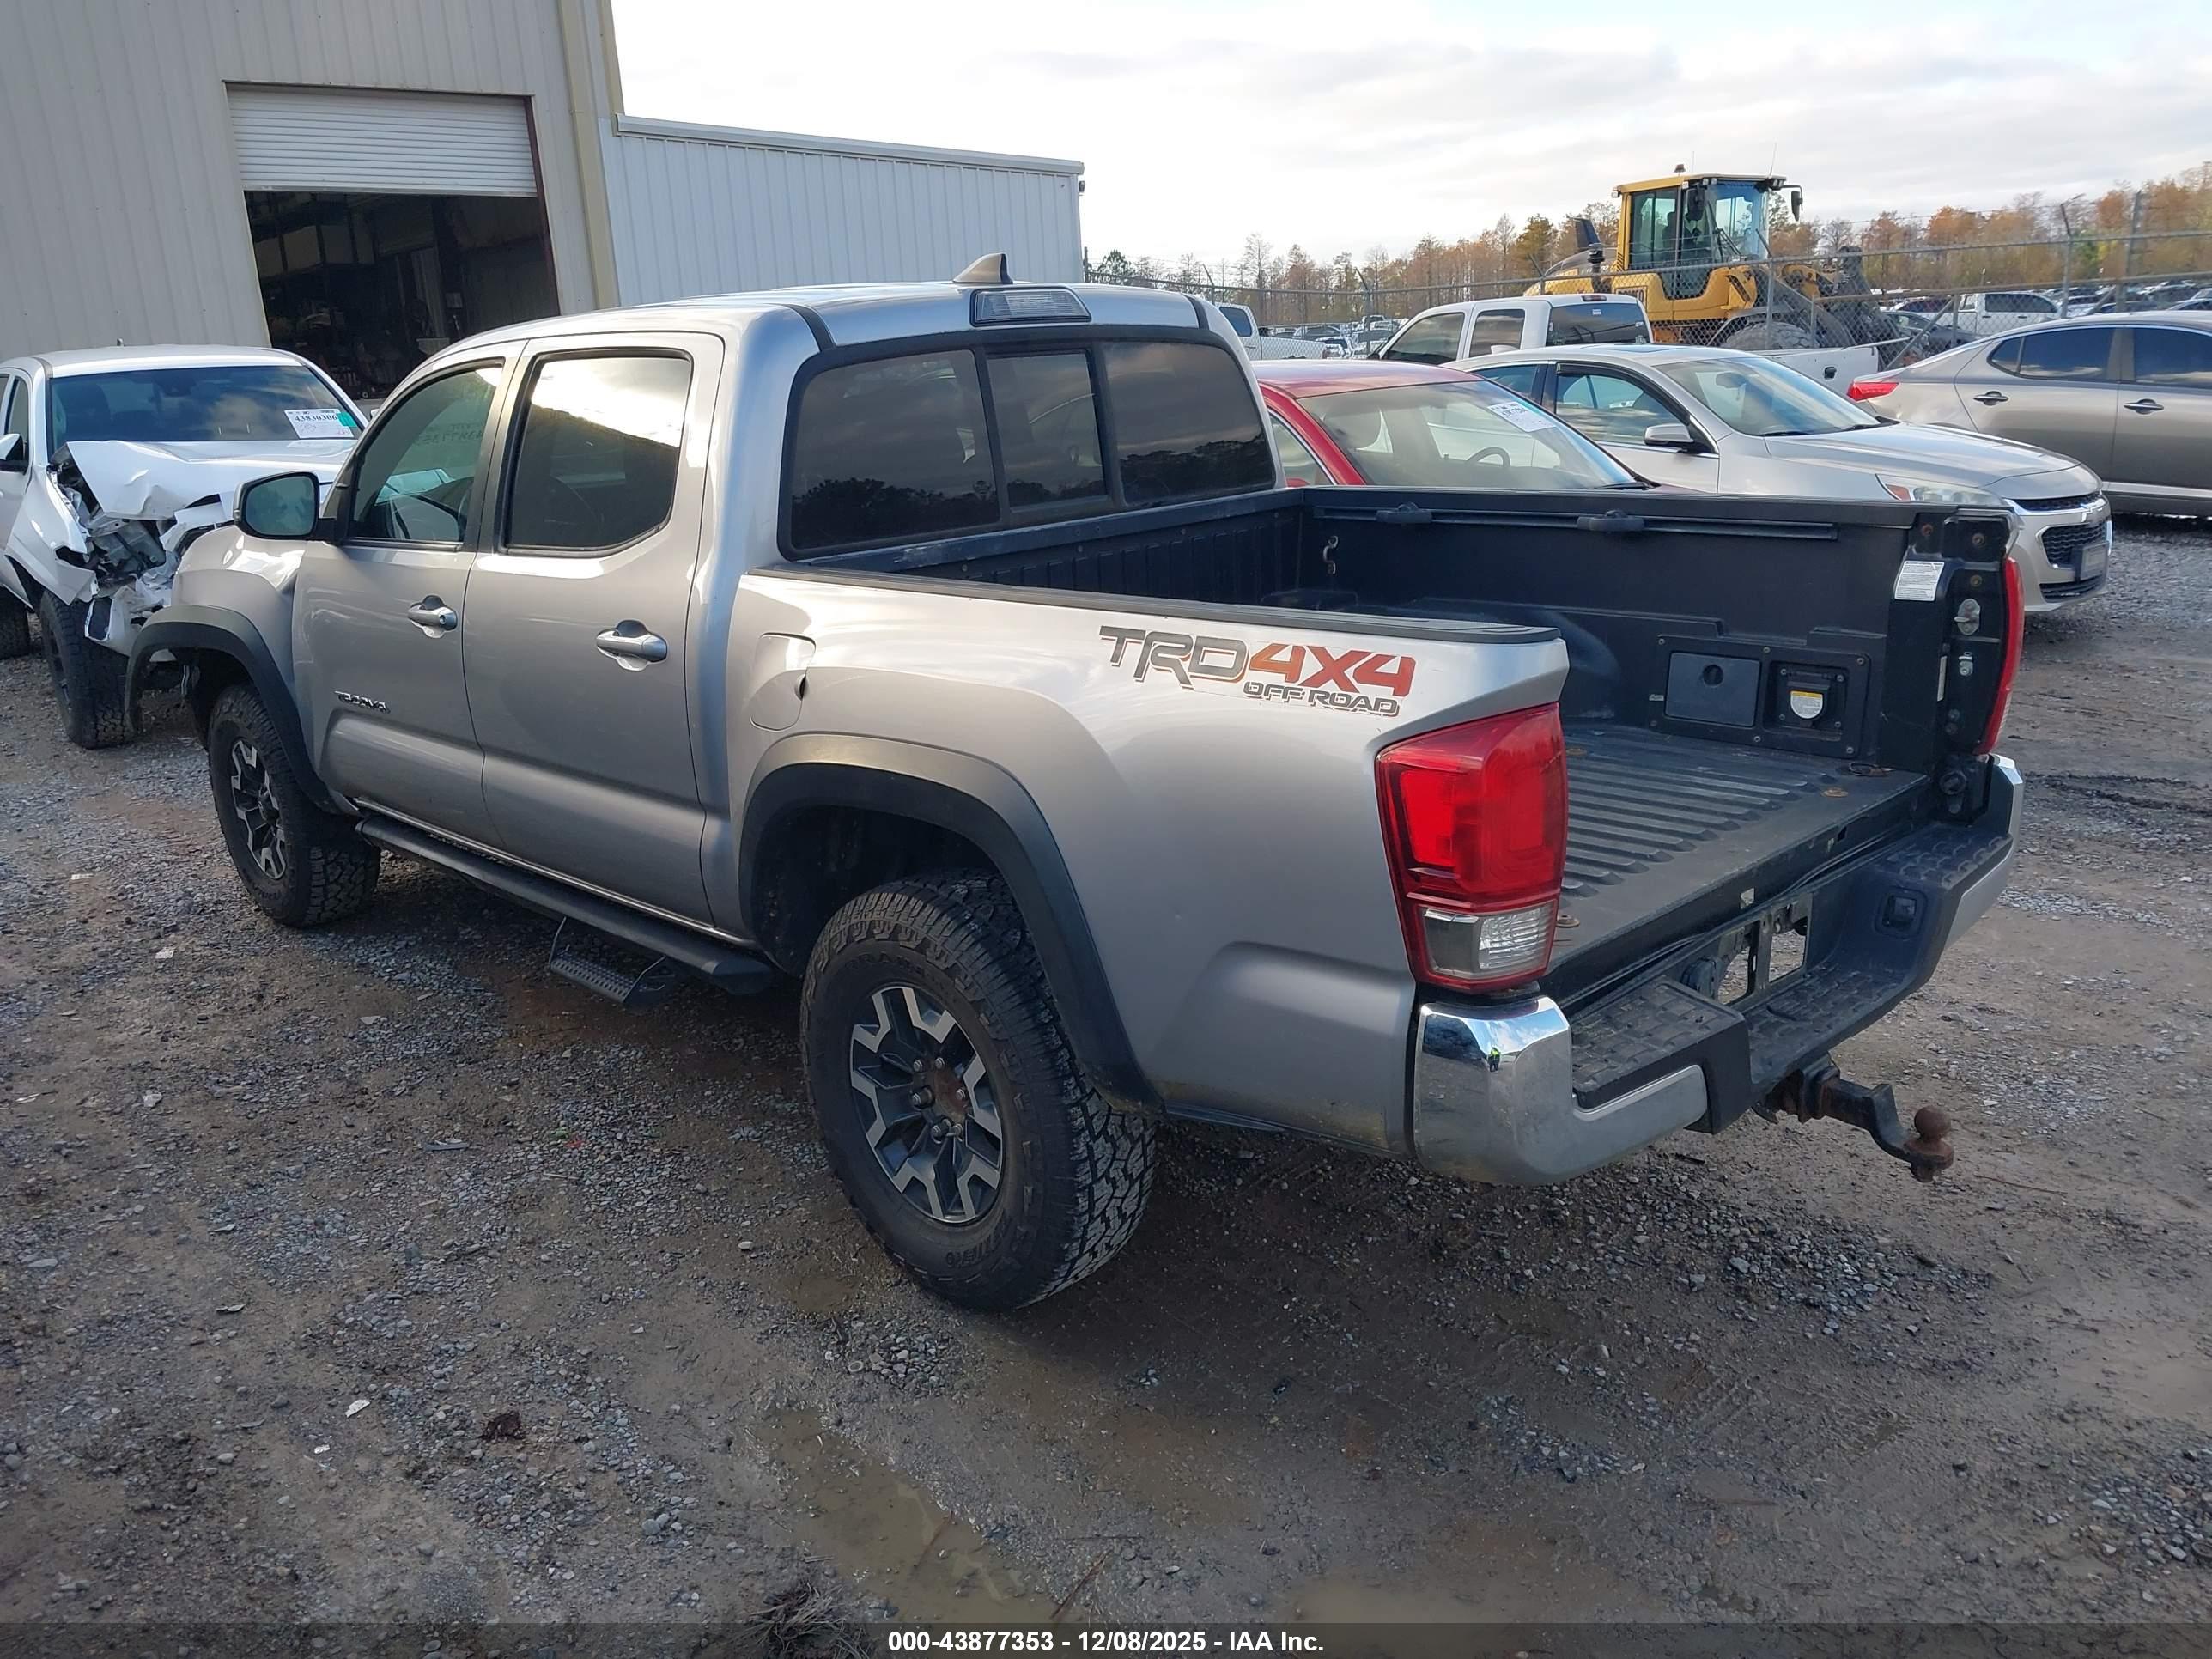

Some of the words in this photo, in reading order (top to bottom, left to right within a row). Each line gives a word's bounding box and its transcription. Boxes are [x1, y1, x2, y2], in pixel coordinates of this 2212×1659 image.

[1099, 625, 1250, 690] TRD
[1243, 681, 1306, 703] OFF
[1307, 689, 1401, 717] ROAD
